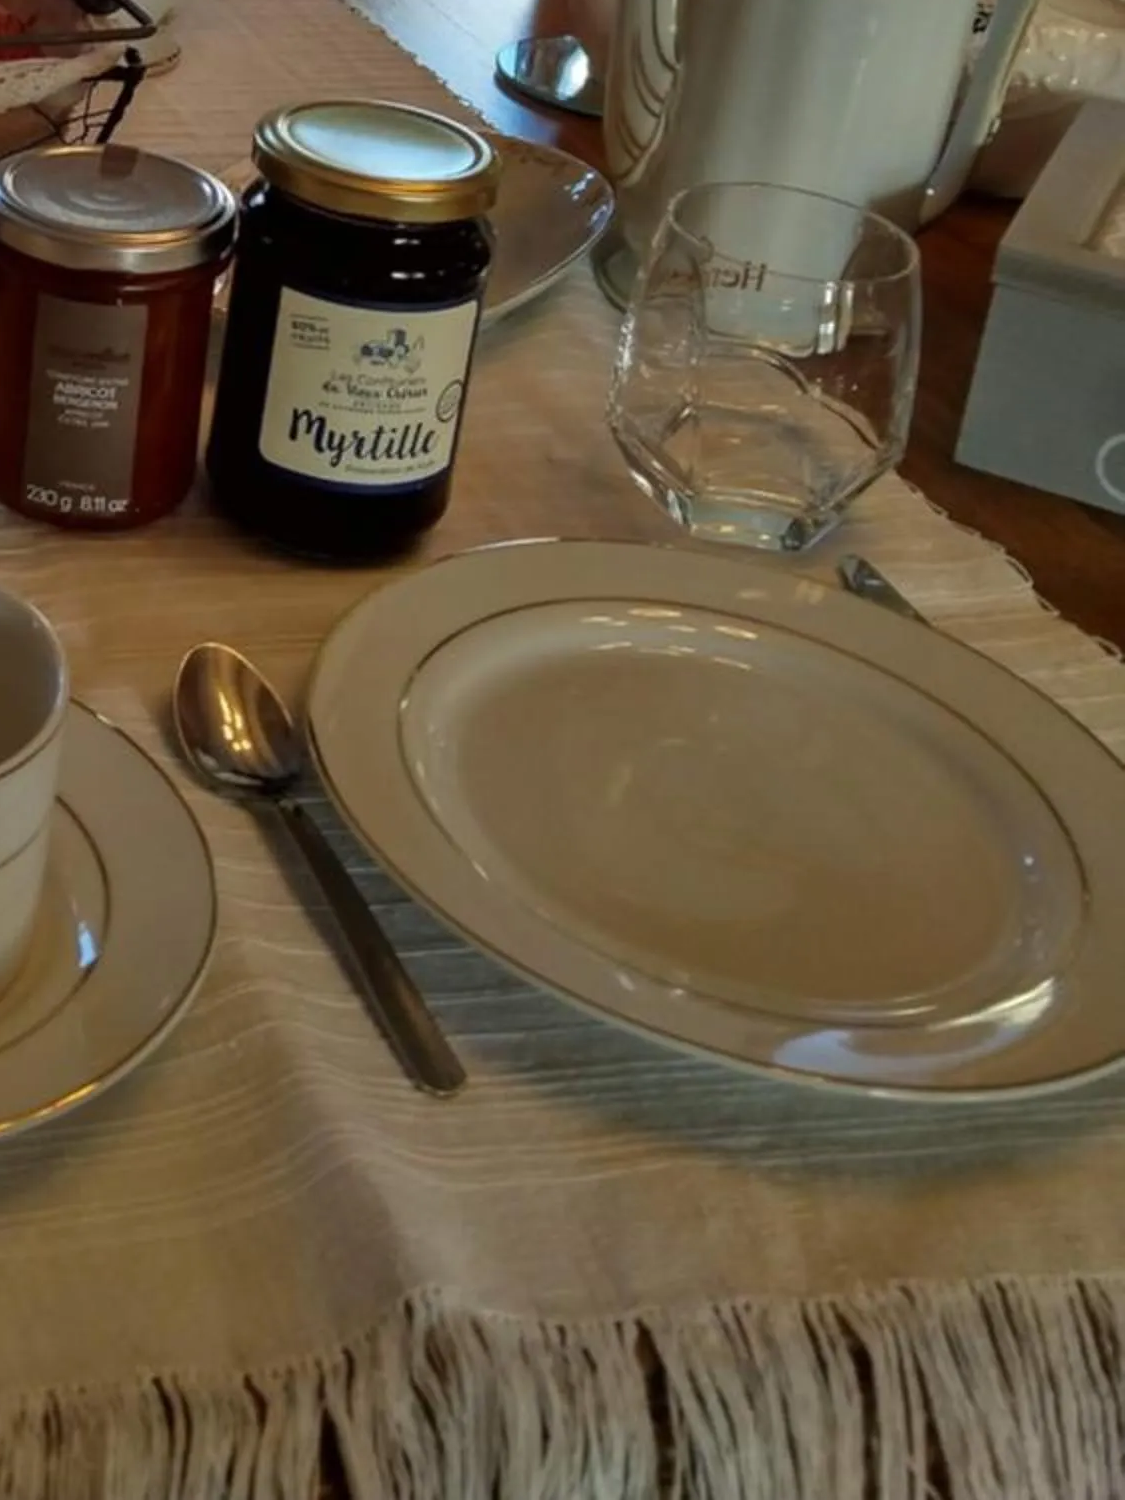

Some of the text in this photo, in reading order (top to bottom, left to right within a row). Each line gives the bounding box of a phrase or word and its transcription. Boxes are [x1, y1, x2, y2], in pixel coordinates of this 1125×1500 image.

[55, 381, 116, 399] ABRICOT
[288, 407, 438, 468] Myrtille
[26, 483, 58, 507] 230
[60, 495, 72, 513] g
